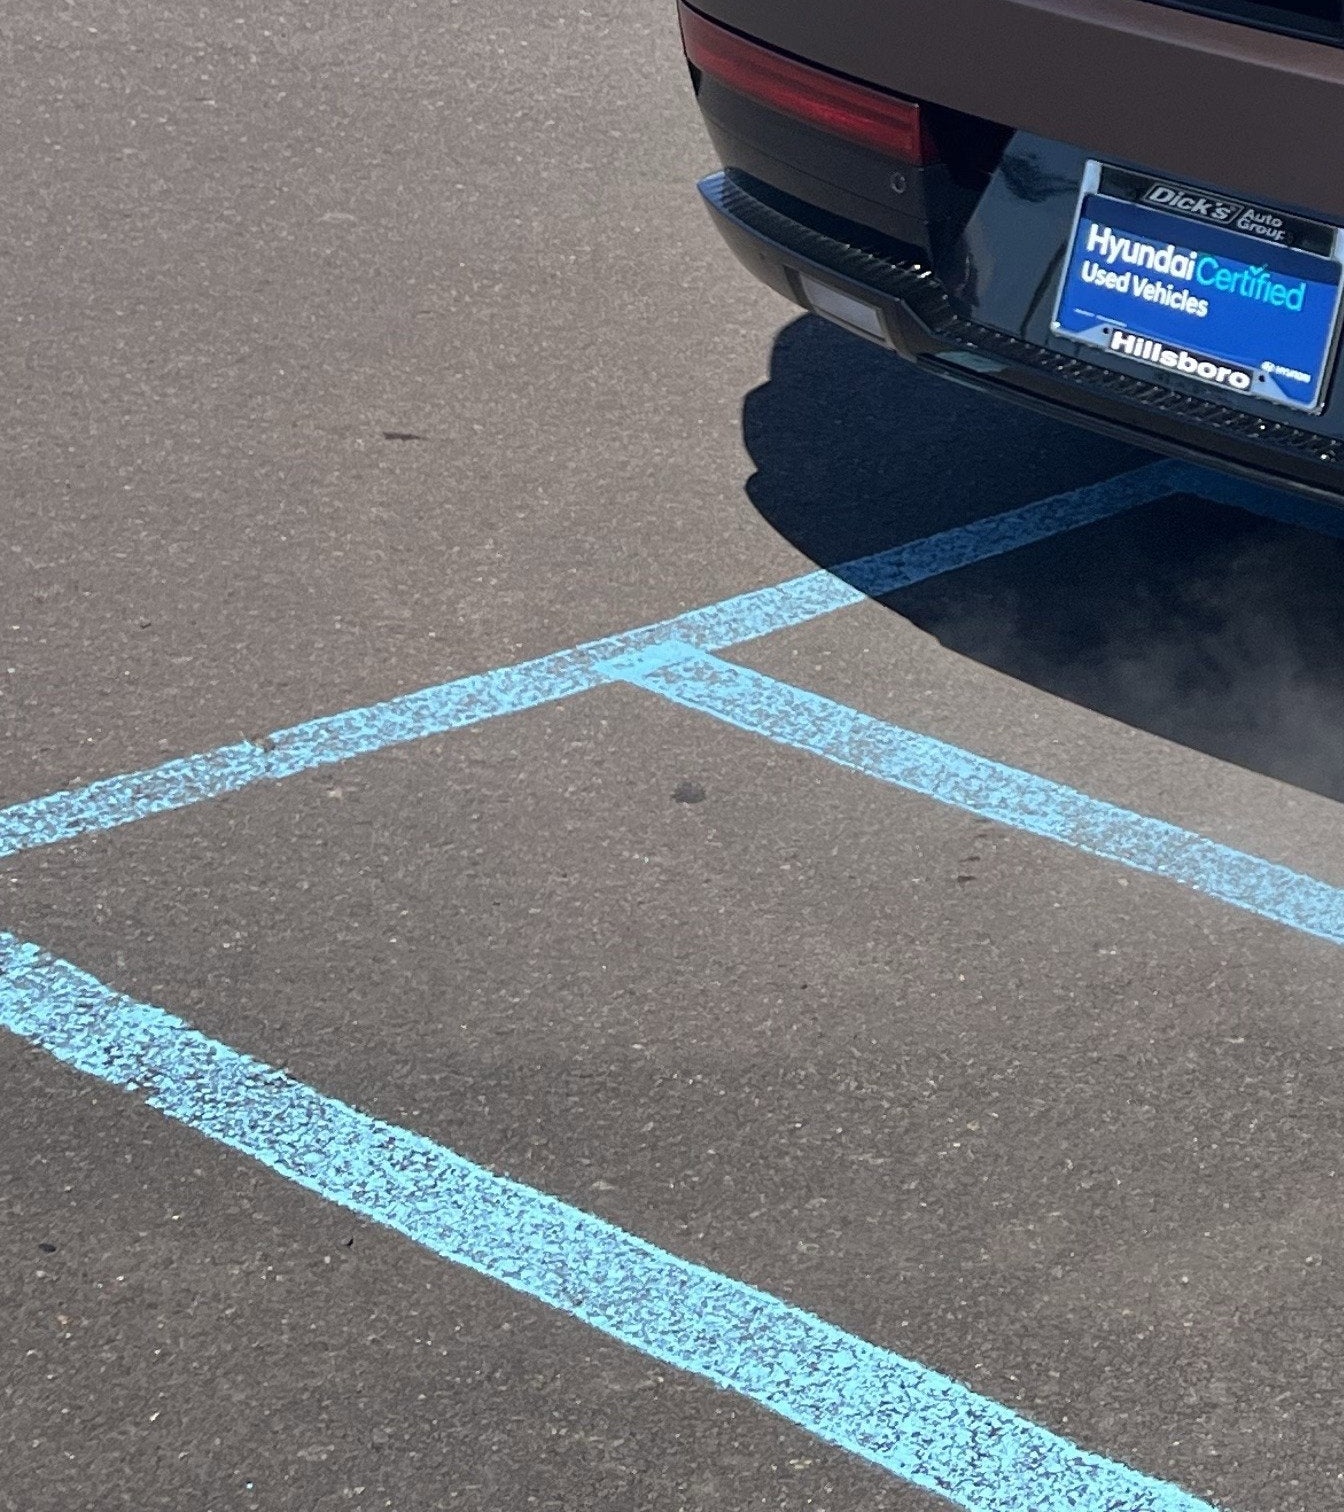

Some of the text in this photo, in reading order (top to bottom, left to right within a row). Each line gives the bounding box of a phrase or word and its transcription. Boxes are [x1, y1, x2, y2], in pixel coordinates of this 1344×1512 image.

[1149, 186, 1231, 221] Dick's
[1241, 208, 1284, 228] Auto
[1081, 260, 1209, 317] Used Vehicles
[1086, 223, 1307, 312] Hyundai Certified
[1110, 330, 1251, 390] Hillsboro
